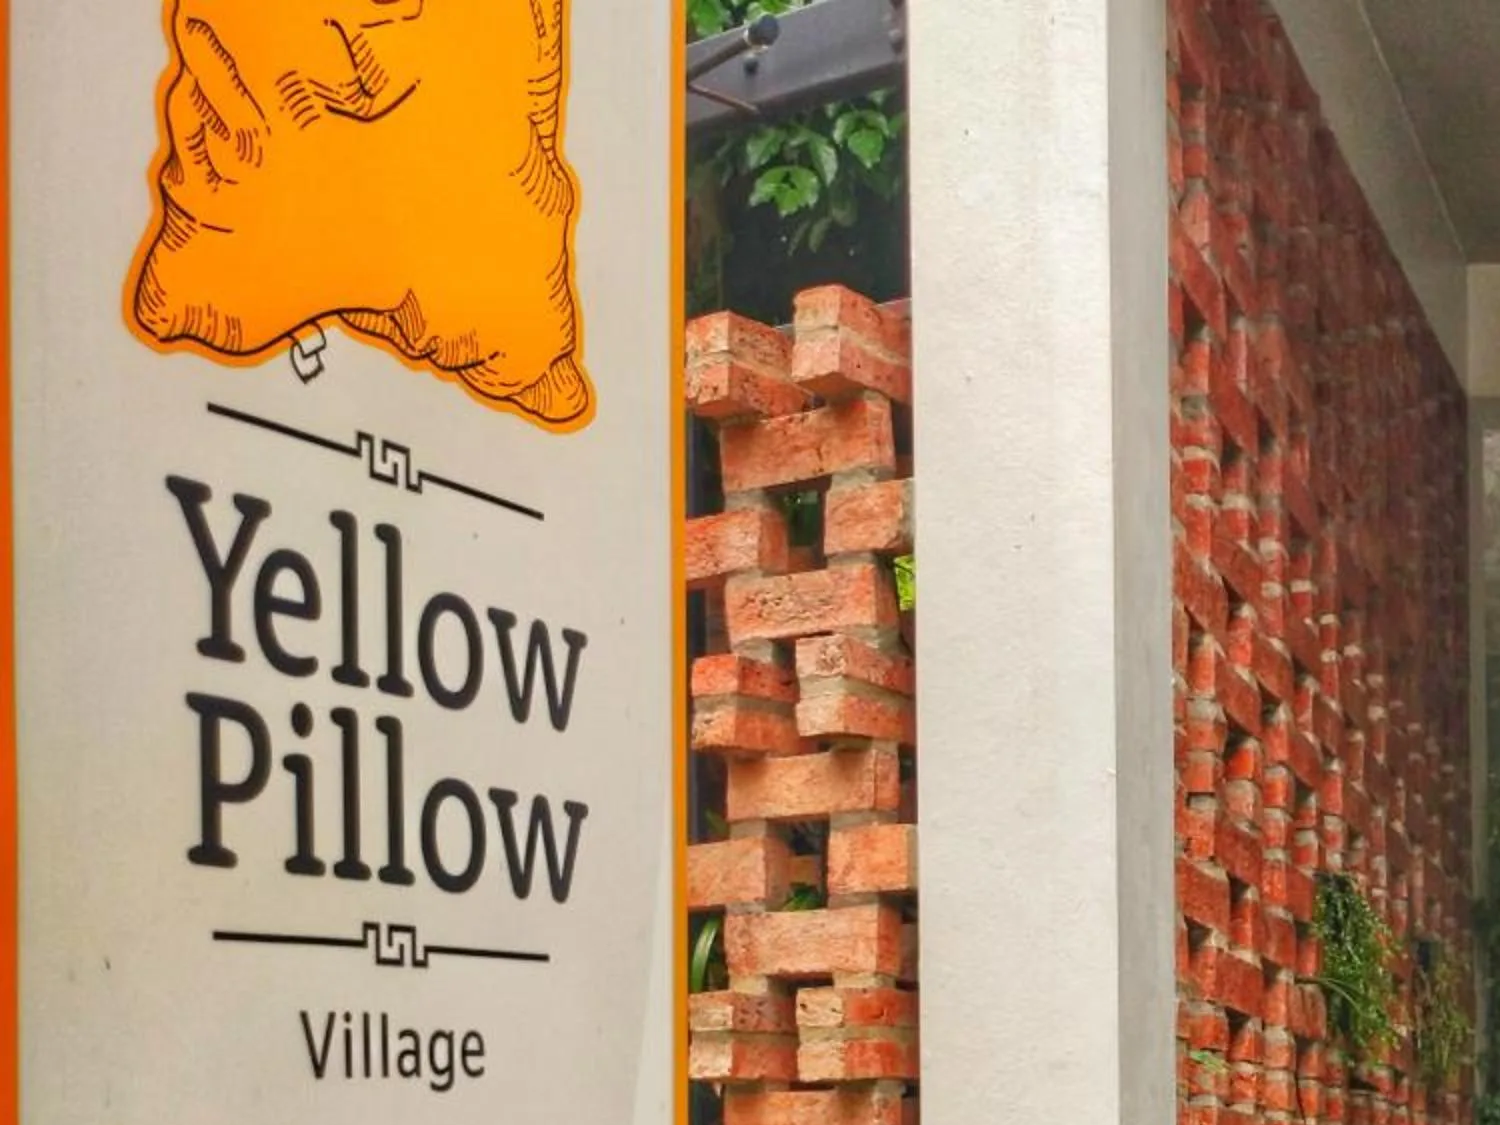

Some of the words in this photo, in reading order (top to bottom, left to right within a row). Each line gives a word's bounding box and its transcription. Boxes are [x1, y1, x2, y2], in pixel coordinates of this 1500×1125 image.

[165, 475, 588, 732] Yellow
[185, 691, 589, 904] Pillow
[300, 1011, 486, 1092] Village
